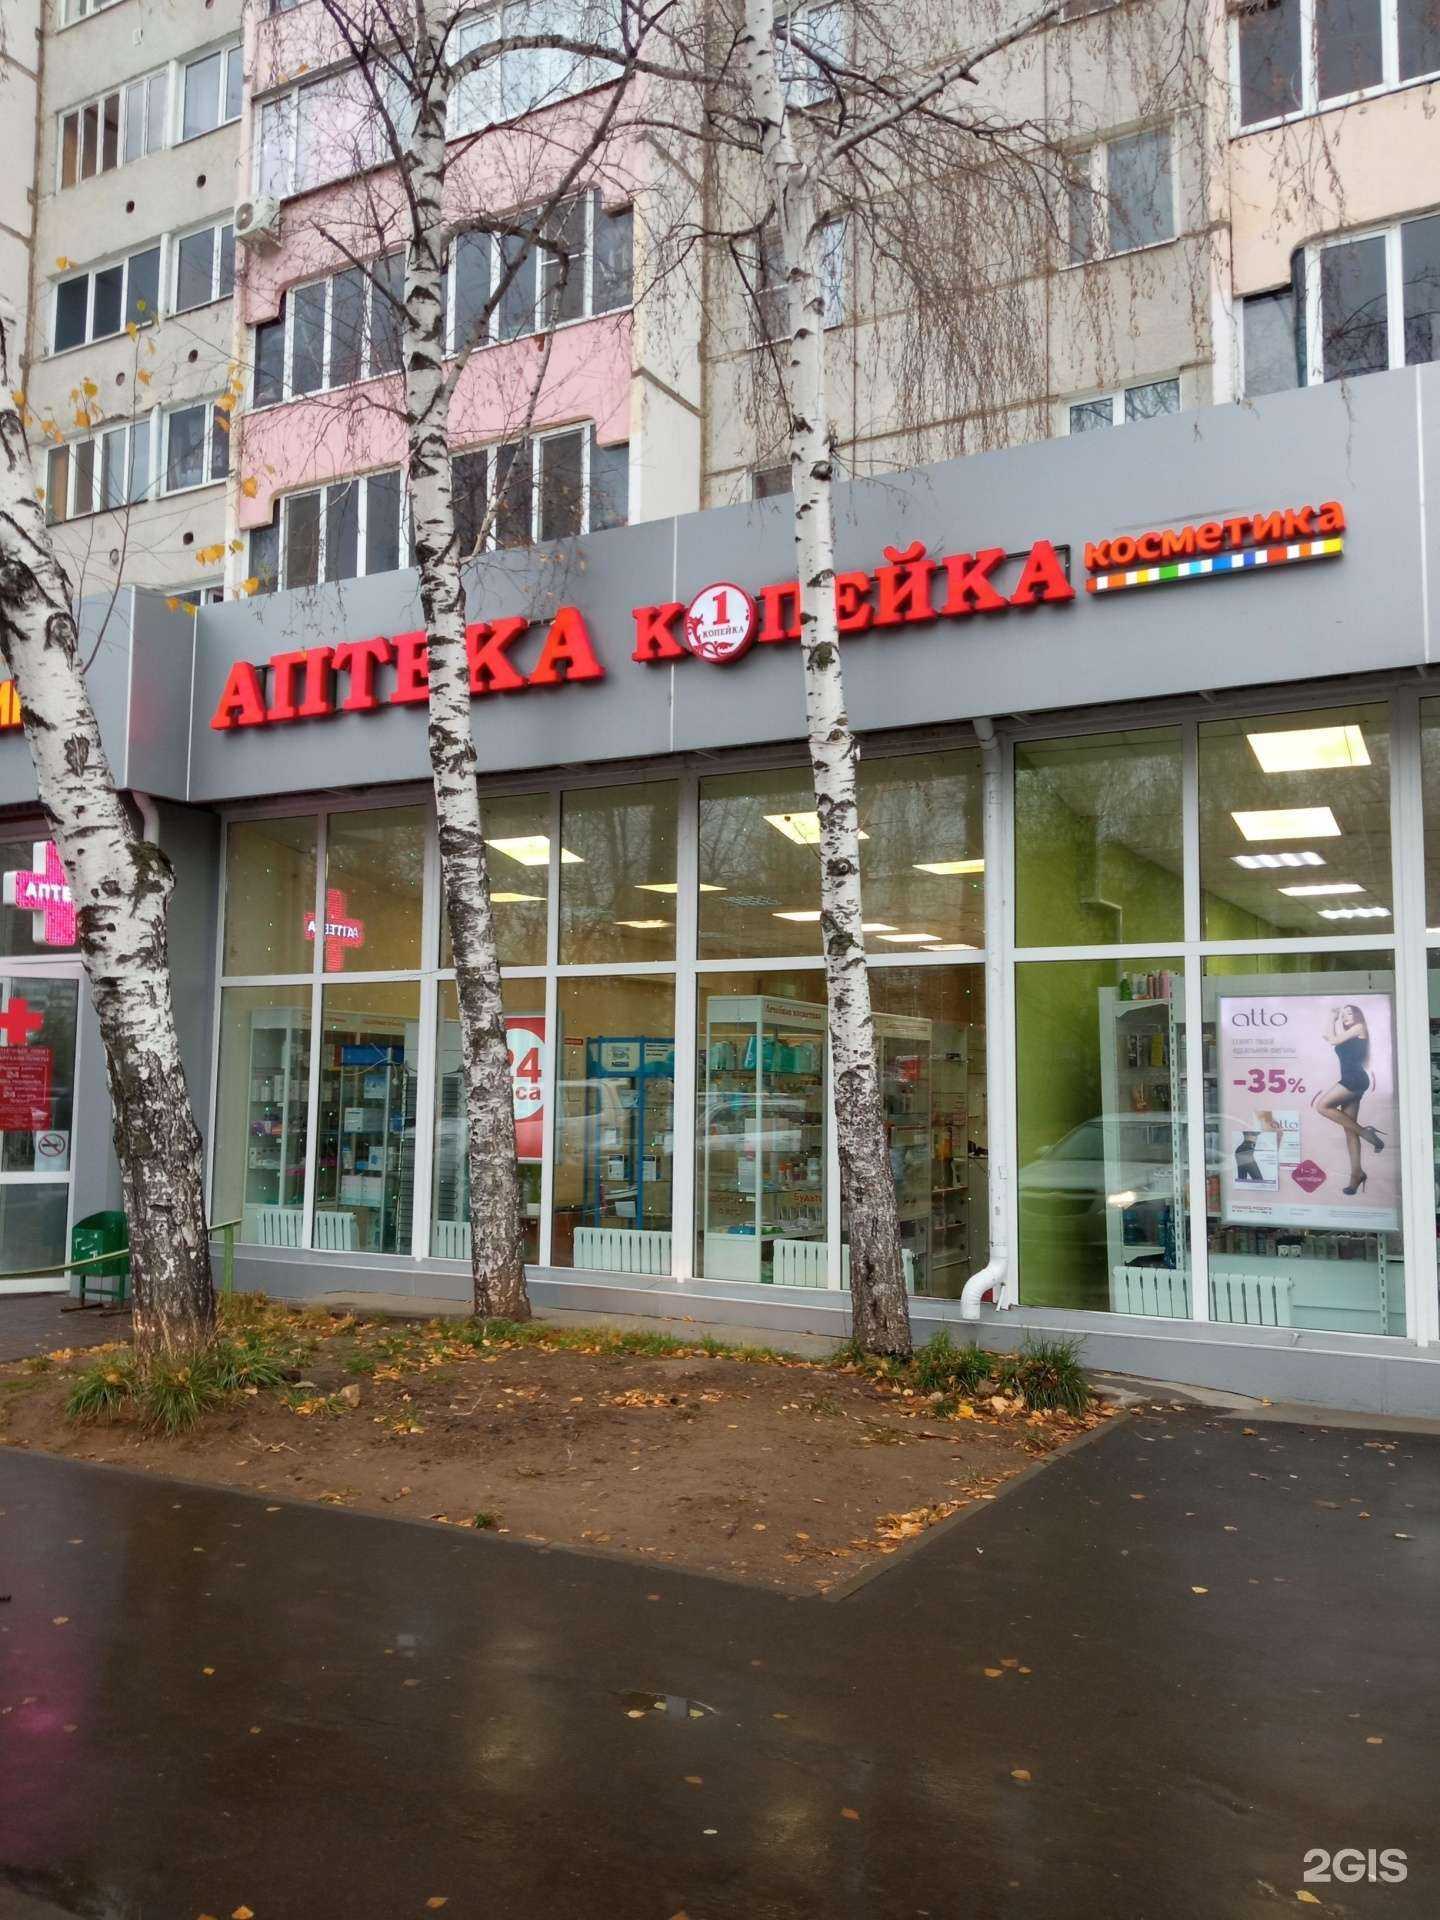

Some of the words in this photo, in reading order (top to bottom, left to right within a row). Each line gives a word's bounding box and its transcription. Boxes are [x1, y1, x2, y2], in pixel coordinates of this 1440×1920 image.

[1084, 501, 1346, 572] косметика
[712, 590, 731, 625] 1
[702, 625, 744, 639] КОПЕЙКА
[209, 606, 605, 731] АПТЕКА
[25, 881, 73, 904] АПТЕ
[1232, 1068, 1307, 1094] -35%
